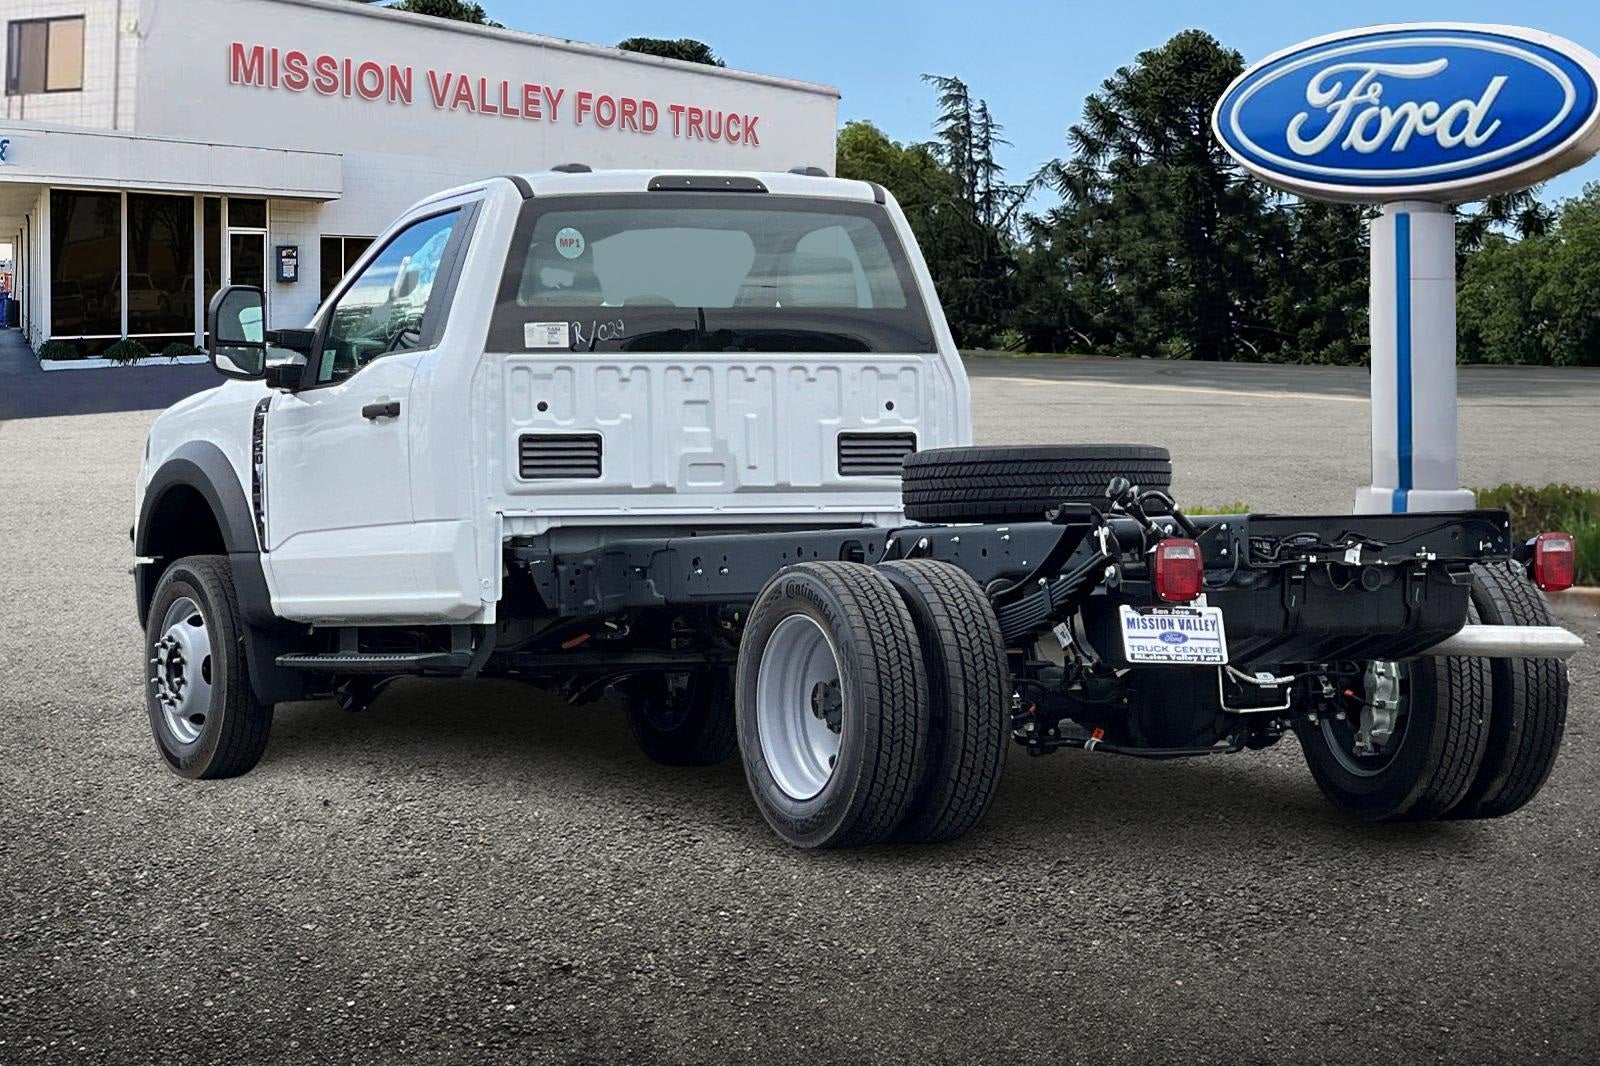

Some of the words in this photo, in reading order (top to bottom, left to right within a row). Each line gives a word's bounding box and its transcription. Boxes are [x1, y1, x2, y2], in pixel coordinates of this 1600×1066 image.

[229, 41, 413, 105] MISSION
[427, 69, 565, 122] VALLEY
[575, 90, 659, 134] FORD
[668, 103, 761, 145] TRUCK
[1286, 58, 1509, 156] Ford
[559, 238, 581, 249] MP1
[785, 580, 837, 622] Continental
[1126, 617, 1175, 630] MISSION
[1178, 619, 1216, 631] VALLEY
[1164, 632, 1183, 643] Ford
[1130, 645, 1169, 653] TRUCK
[1174, 646, 1221, 654] CENTER
[1133, 653, 1168, 661] Mission
[1170, 653, 1198, 662] Valley
